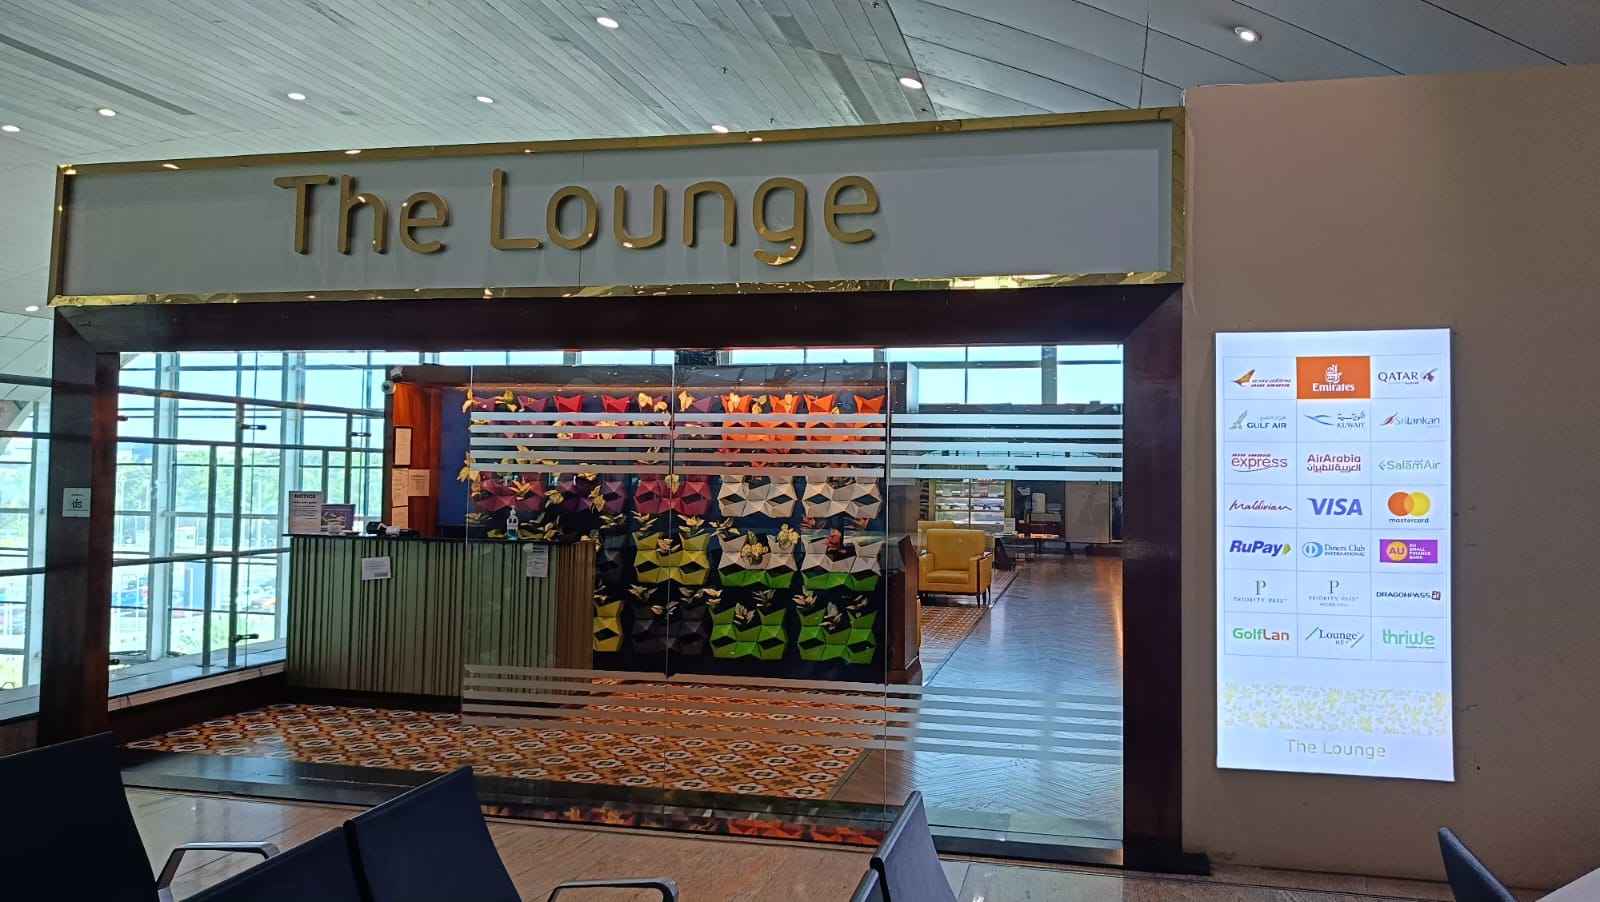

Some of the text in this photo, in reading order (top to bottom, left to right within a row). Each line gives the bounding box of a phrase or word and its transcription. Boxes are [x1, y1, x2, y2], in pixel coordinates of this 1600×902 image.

[273, 167, 880, 266] The Lounge
[1377, 371, 1419, 383] QATAR
[1312, 383, 1355, 392] Emirates
[1395, 415, 1440, 425] SriLankan
[1231, 457, 1288, 470] express
[1307, 498, 1363, 516] VISA
[1229, 540, 1283, 557] RuPay
[1324, 543, 1366, 552] Diners Club
[1389, 546, 1406, 555] AU
[1232, 627, 1290, 641] GolfLan
[1319, 629, 1358, 641] Lounge
[1287, 739, 1386, 760] The Lounge
